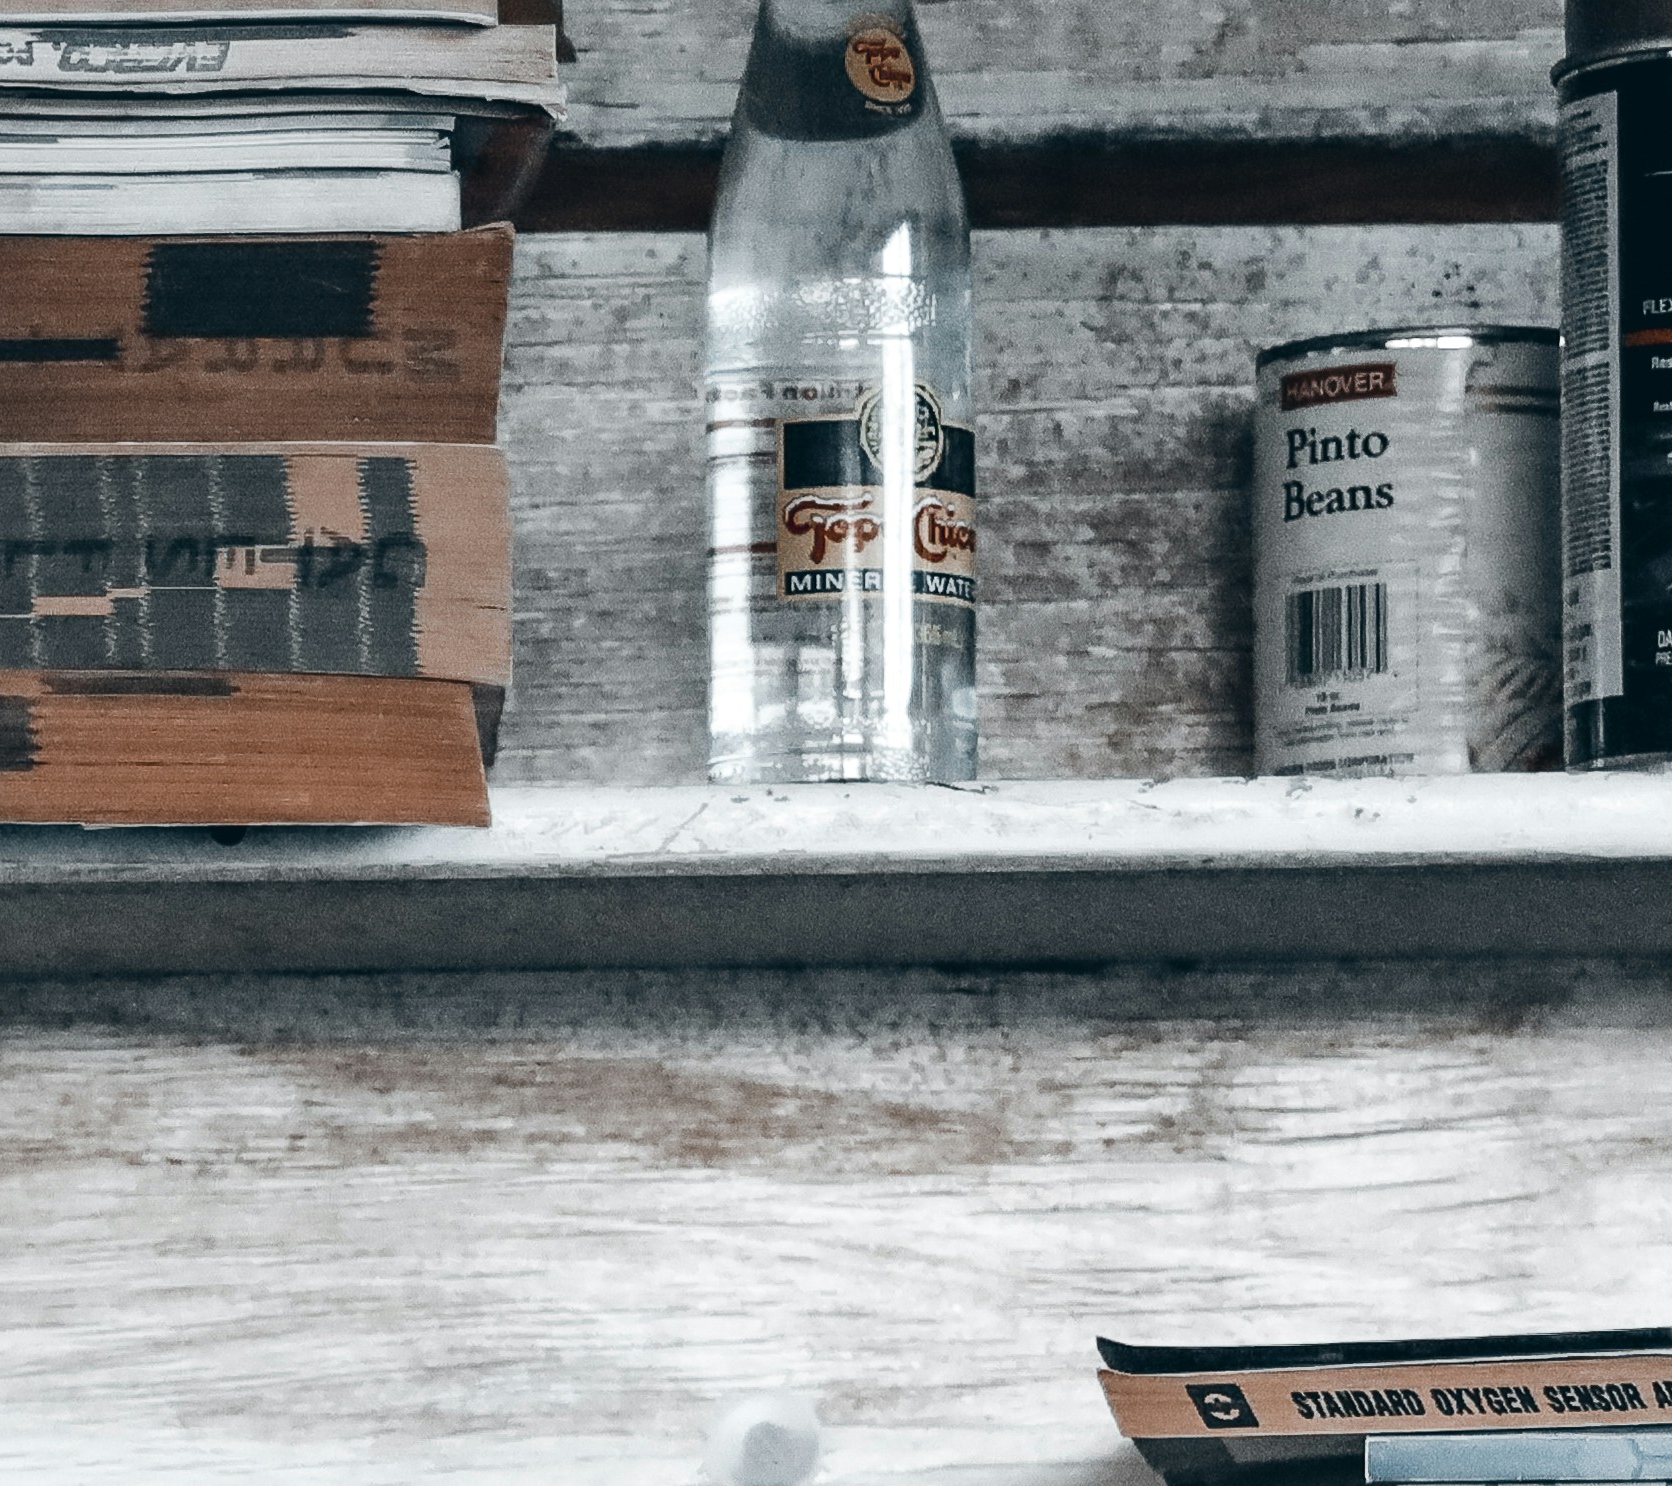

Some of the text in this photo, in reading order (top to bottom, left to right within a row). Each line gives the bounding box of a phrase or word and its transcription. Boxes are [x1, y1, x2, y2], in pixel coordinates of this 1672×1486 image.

[1287, 370, 1386, 402] HANOVER
[1285, 427, 1390, 470] Pinto
[1283, 481, 1394, 523] Beans
[783, 493, 882, 565] Top
[1289, 1387, 1427, 1420] STANDARD
[1429, 1385, 1541, 1417] OXYGEN
[1542, 1381, 1648, 1414] SENSOR
